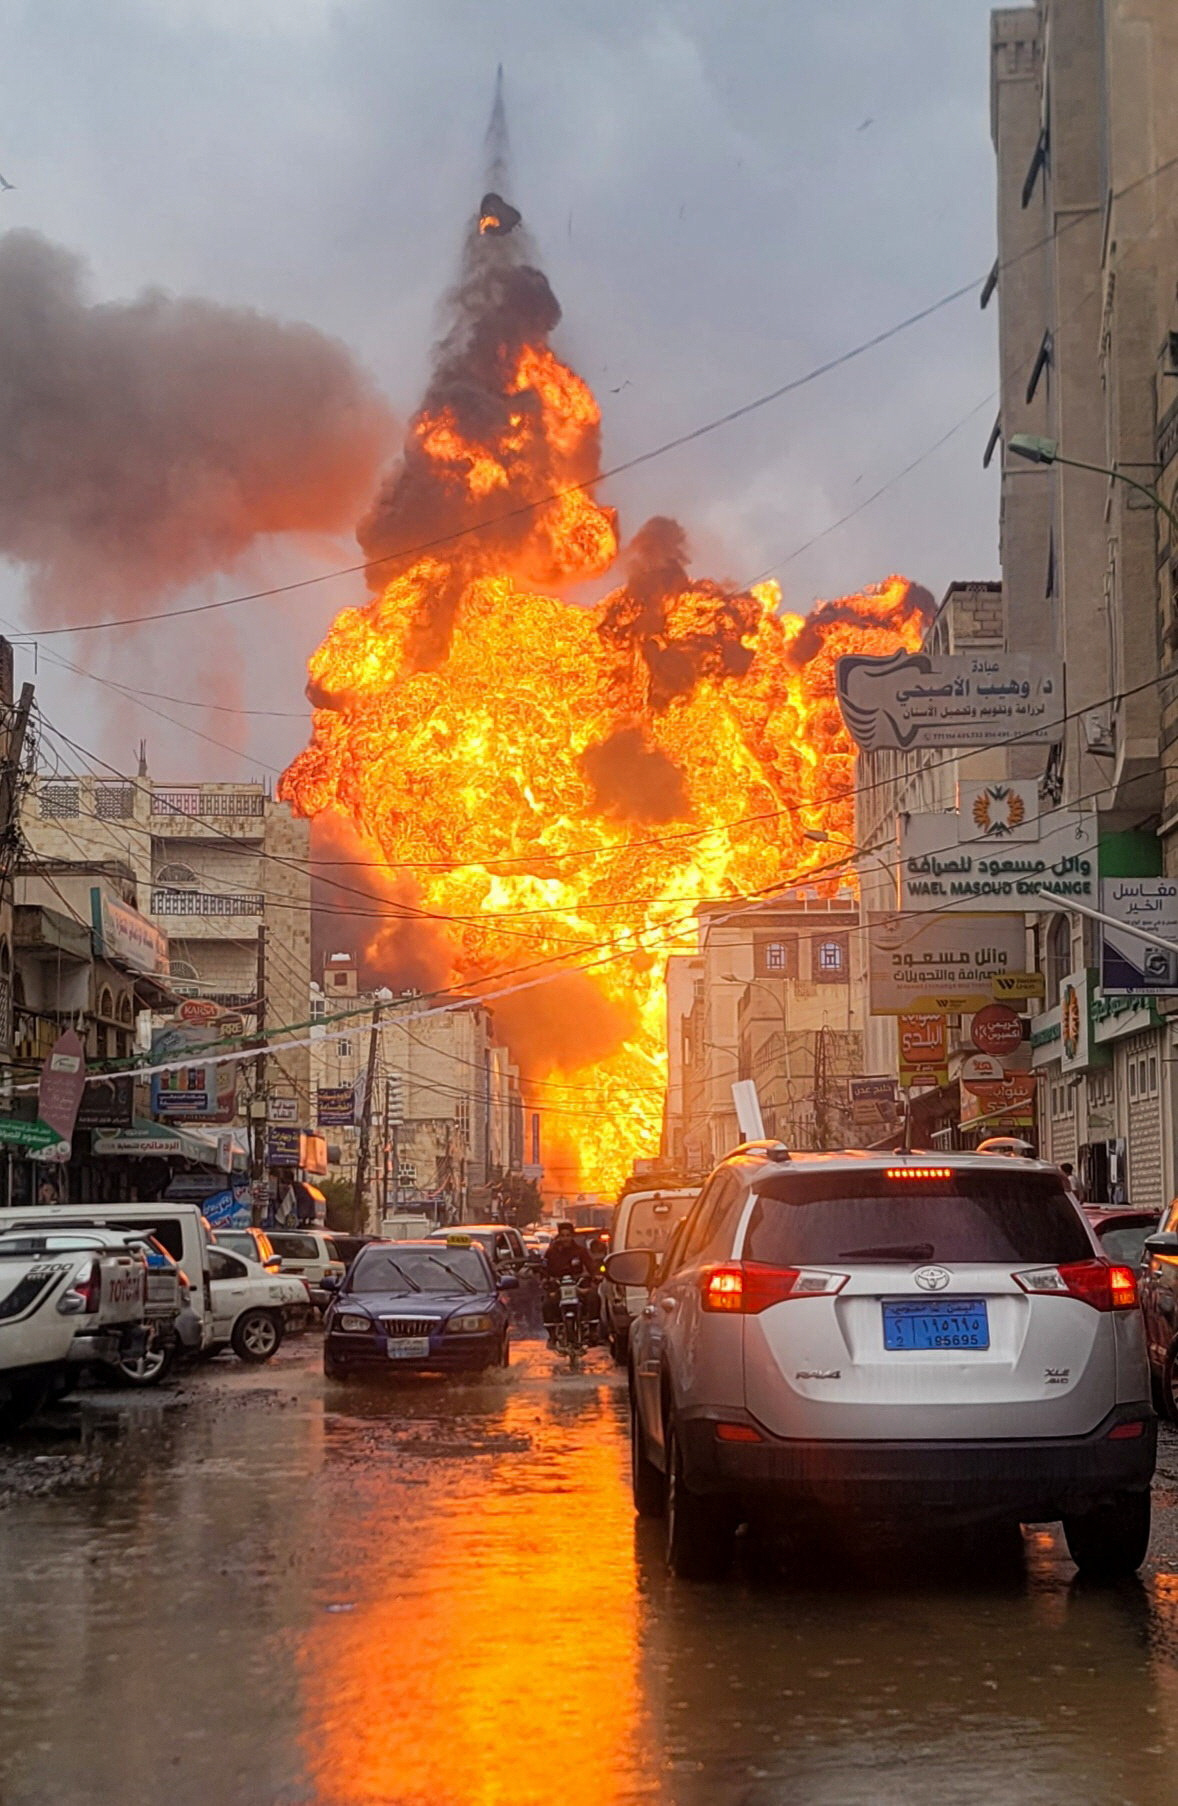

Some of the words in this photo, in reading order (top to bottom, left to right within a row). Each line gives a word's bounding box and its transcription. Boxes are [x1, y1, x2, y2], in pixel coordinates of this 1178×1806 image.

[896, 675, 970, 706] الأصبحي
[977, 679, 1030, 699] وهيب
[907, 855, 972, 876] للصرافة
[978, 860, 1046, 876] مسعود
[1051, 856, 1091, 876] وائل
[907, 881, 947, 895] WAEL
[950, 881, 1012, 895] MASOUD
[1016, 881, 1091, 895] EXCHANGE
[1112, 883, 1177, 900] مغاسل
[1126, 899, 1163, 915] الخير
[892, 952, 970, 968] مسعود
[975, 948, 1008, 966] وائل
[30, 1263, 75, 1272] 2700
[927, 1334, 978, 1346] 195695
